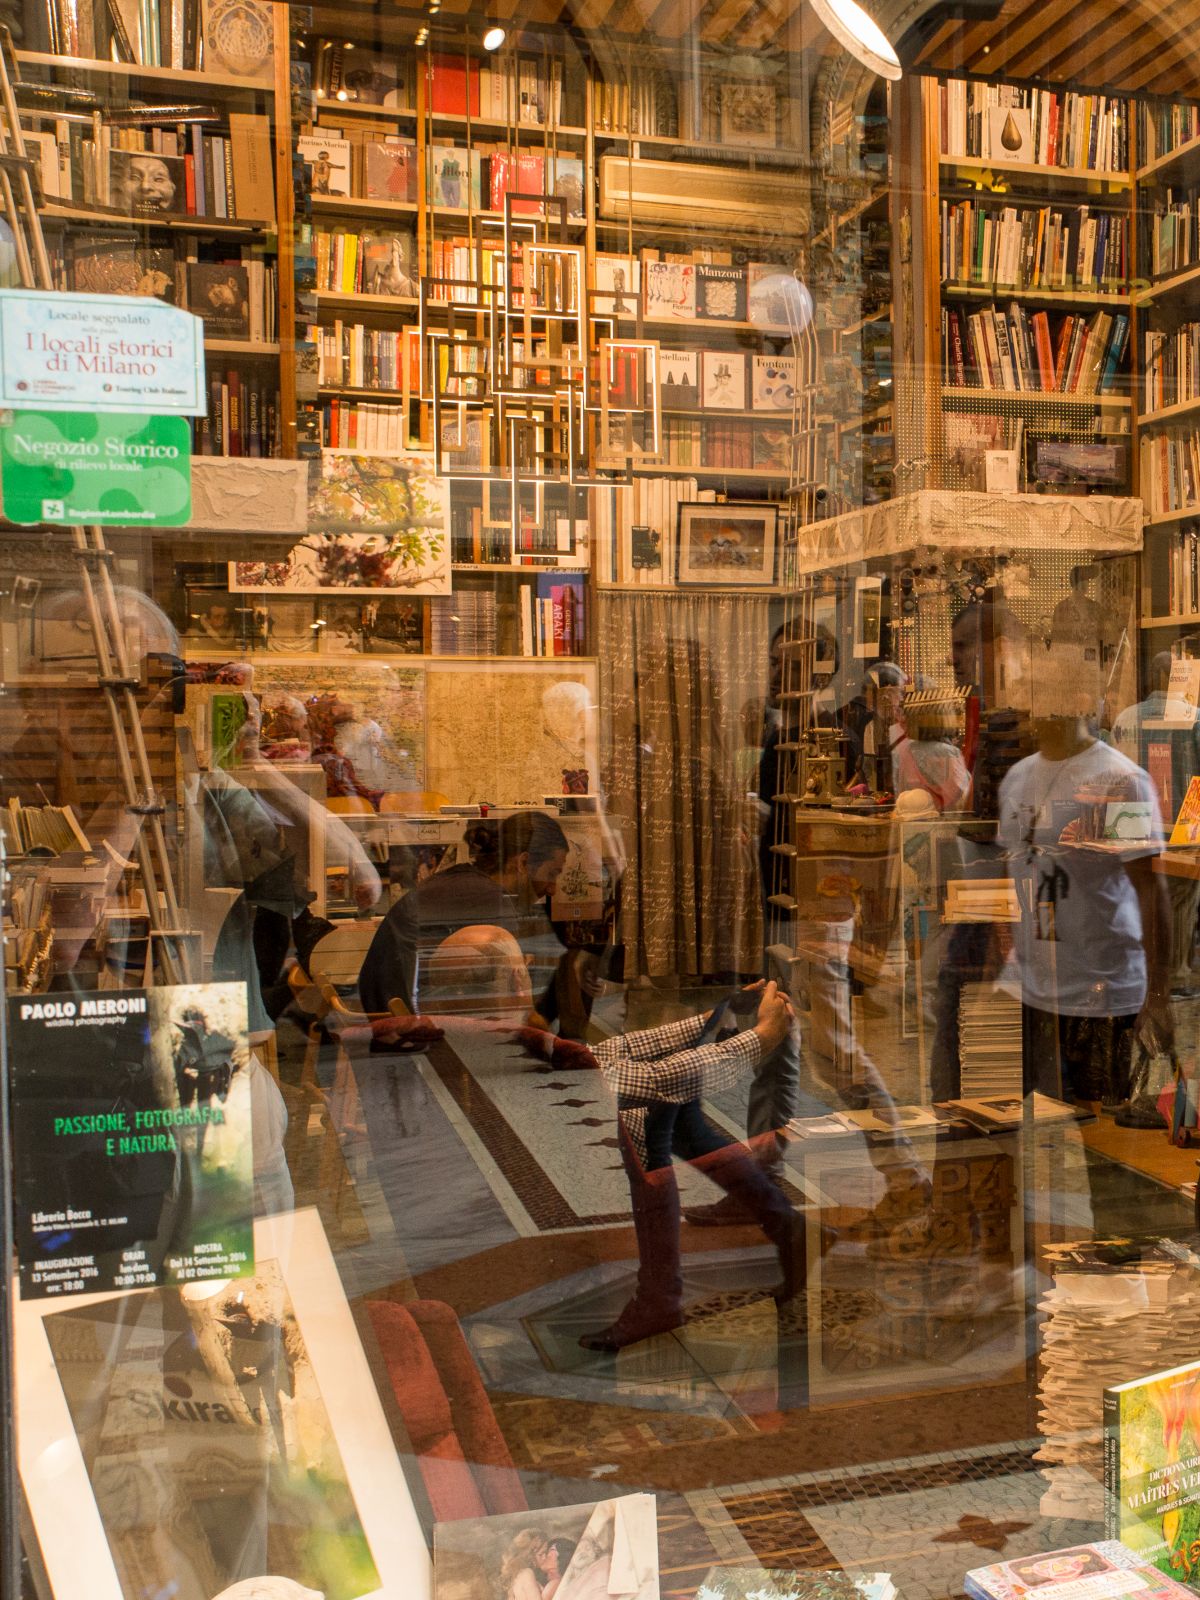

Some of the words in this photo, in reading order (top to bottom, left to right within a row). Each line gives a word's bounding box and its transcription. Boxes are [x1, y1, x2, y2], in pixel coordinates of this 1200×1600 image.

[323, 140, 348, 150] Marini
[699, 266, 743, 279] Manzoni
[49, 309, 88, 321] Locale
[92, 313, 150, 326] segnalato
[26, 333, 33, 350] I
[42, 333, 100, 354] locali
[108, 340, 174, 359] storici
[954, 337, 963, 361] Charles
[46, 353, 68, 372] di
[76, 354, 156, 376] Milano
[656, 353, 691, 362] stellani
[757, 358, 794, 369] Fontana
[115, 385, 142, 395] Touring
[143, 386, 160, 394] Club
[13, 434, 99, 459] Negozio
[104, 436, 179, 460] Storico
[55, 460, 67, 469] di
[69, 460, 107, 471] rilievo
[109, 461, 143, 472] locale
[553, 604, 563, 640] ARAKI
[21, 1002, 77, 1020] PAOLO
[81, 998, 147, 1016] MERONI
[45, 1018, 75, 1028] wildlife
[75, 1015, 127, 1027] photography
[54, 1112, 131, 1136] PASSIONE,
[135, 1106, 225, 1128] FOTOGRAFIA
[106, 1139, 115, 1156] E
[119, 1134, 178, 1156] NATURA
[32, 1211, 66, 1224] Libreria
[67, 1209, 91, 1221] Bocca
[193, 1243, 223, 1253] MOSTRA
[34, 1255, 95, 1271] INAUGURAZIONE
[122, 1250, 145, 1262] ORARI
[184, 1257, 193, 1267] 14
[193, 1254, 229, 1266] Settembre
[229, 1252, 247, 1262] 2016
[32, 1273, 41, 1283] 13
[42, 1270, 79, 1283] Settembre
[80, 1268, 98, 1279] 2016
[197, 1265, 223, 1277] Ottobre
[223, 1264, 240, 1274] 2016
[63, 1281, 85, 1292] 18:00
[1128, 1479, 1181, 1509] MAÎTRES
[1156, 1502, 1178, 1514] MARQUES
